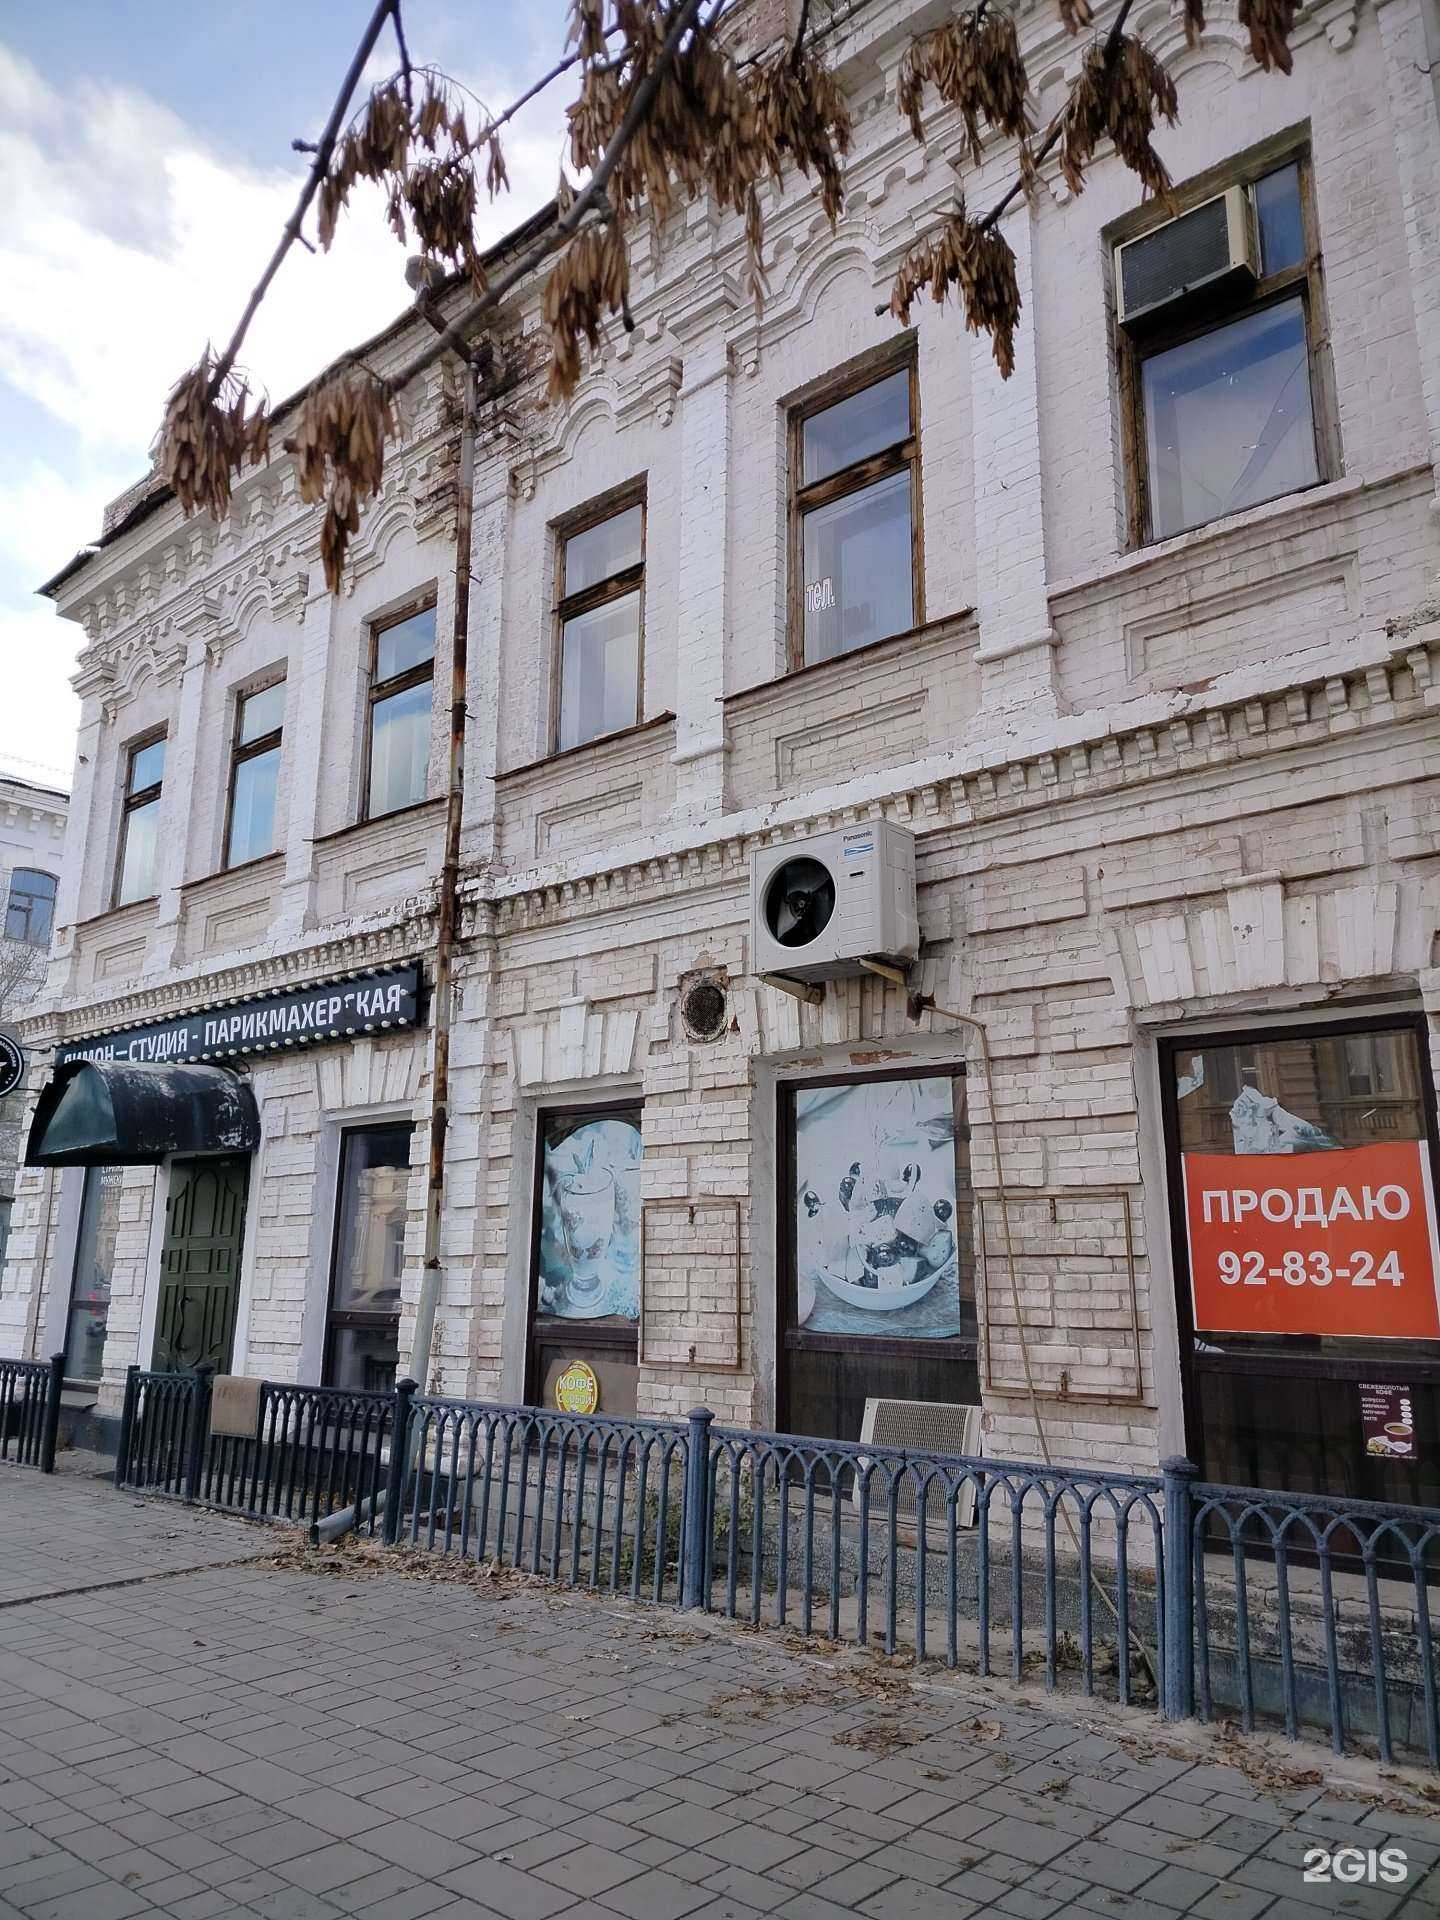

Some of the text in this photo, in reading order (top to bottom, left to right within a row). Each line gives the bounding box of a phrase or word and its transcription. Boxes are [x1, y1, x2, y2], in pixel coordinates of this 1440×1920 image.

[806, 577, 836, 612] тел.
[843, 831, 873, 841] Panasonic
[1203, 1184, 1410, 1228] ПРОДАЮ
[1218, 1250, 1404, 1286] 92-83-24
[560, 1376, 593, 1392] КОФЕ
